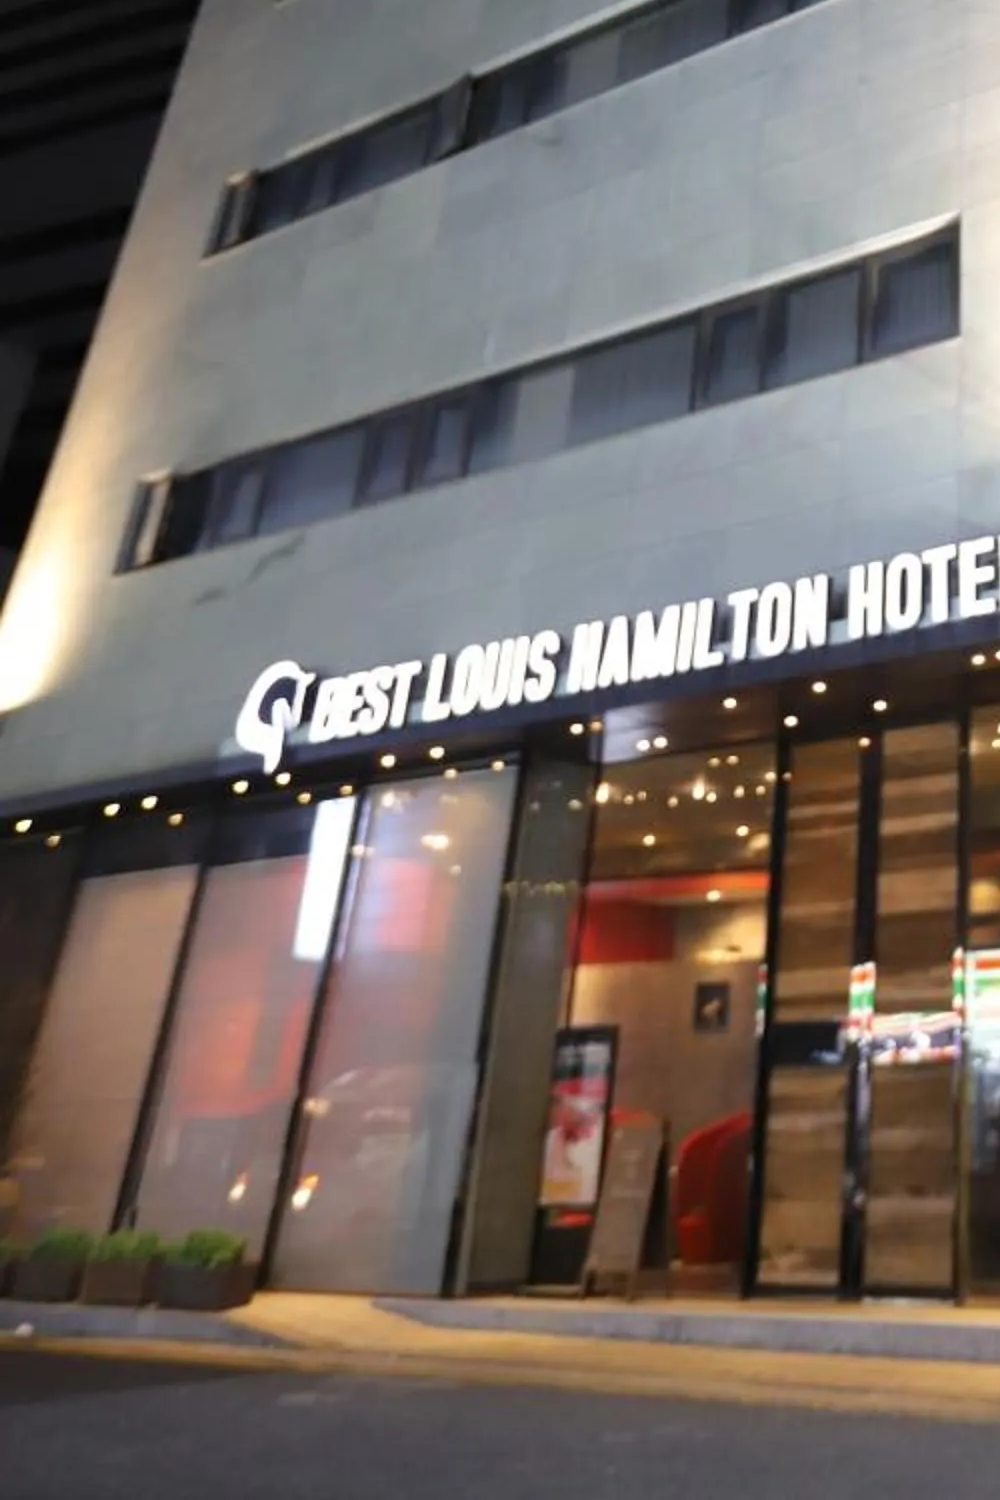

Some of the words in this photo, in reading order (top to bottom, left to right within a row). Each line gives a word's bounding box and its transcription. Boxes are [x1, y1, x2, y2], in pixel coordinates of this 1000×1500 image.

[308, 660, 422, 742] BEST
[421, 630, 561, 721] LOUIS
[567, 573, 829, 692] HAMILTON
